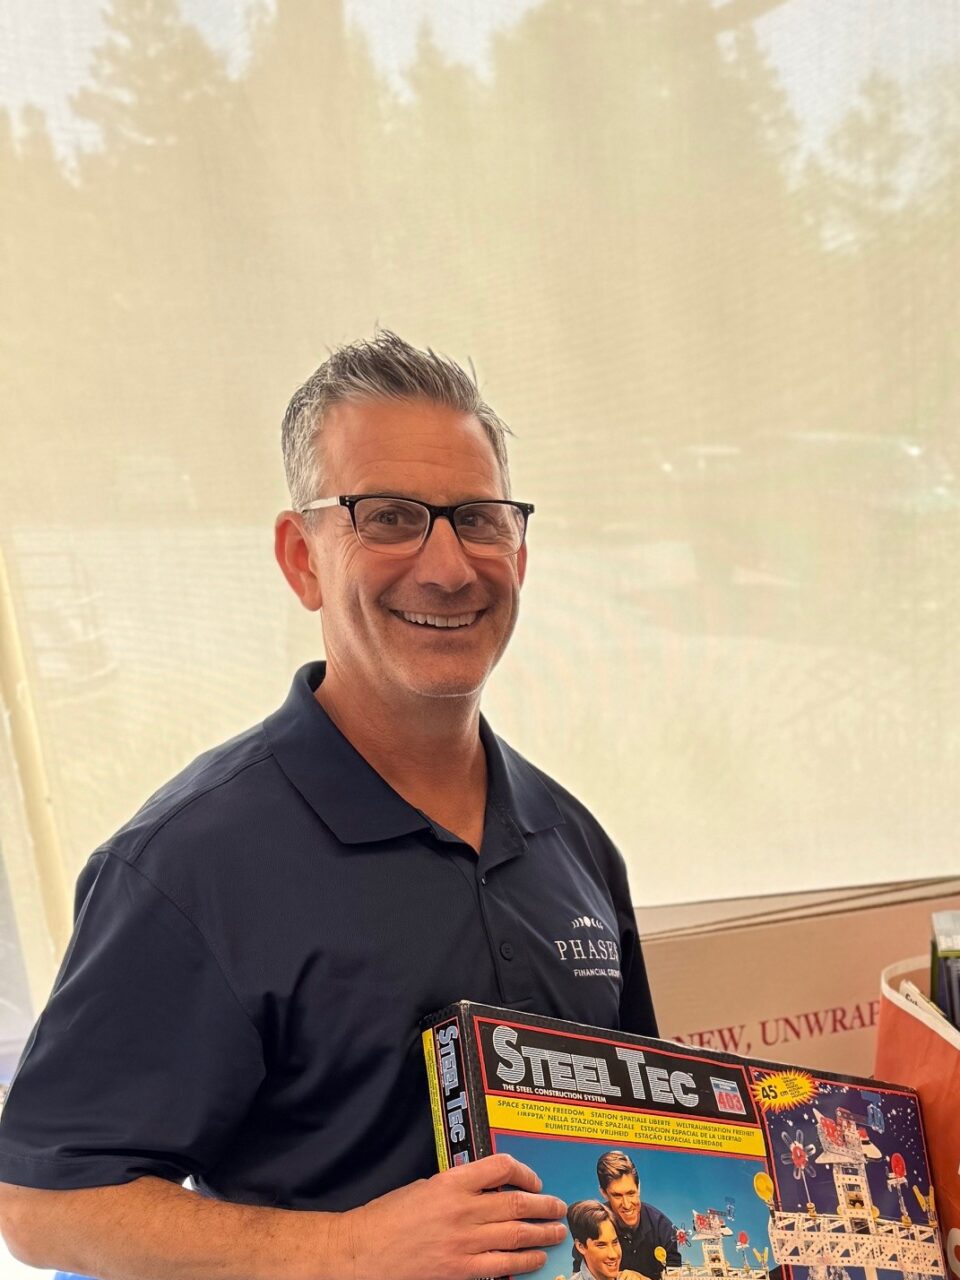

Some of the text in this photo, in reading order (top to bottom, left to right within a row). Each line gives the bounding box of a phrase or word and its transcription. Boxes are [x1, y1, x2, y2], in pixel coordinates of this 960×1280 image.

[439, 1025, 459, 1096] STEEL
[493, 1025, 699, 1108] STEEL TEC
[502, 1083, 607, 1103] THE STEEL CONSTRUCTION SYSTEM
[497, 1100, 585, 1116] SPACE STATION FREEDOM
[590, 1111, 618, 1120] STATION
[446, 1091, 468, 1143] TEC
[547, 1115, 569, 1123] NELLA
[571, 1117, 604, 1127] STAZIONE
[605, 1121, 635, 1130] SPAZIALE
[664, 1135, 692, 1144] ESPACIAL
[672, 1129, 699, 1138] ESPACIAL
